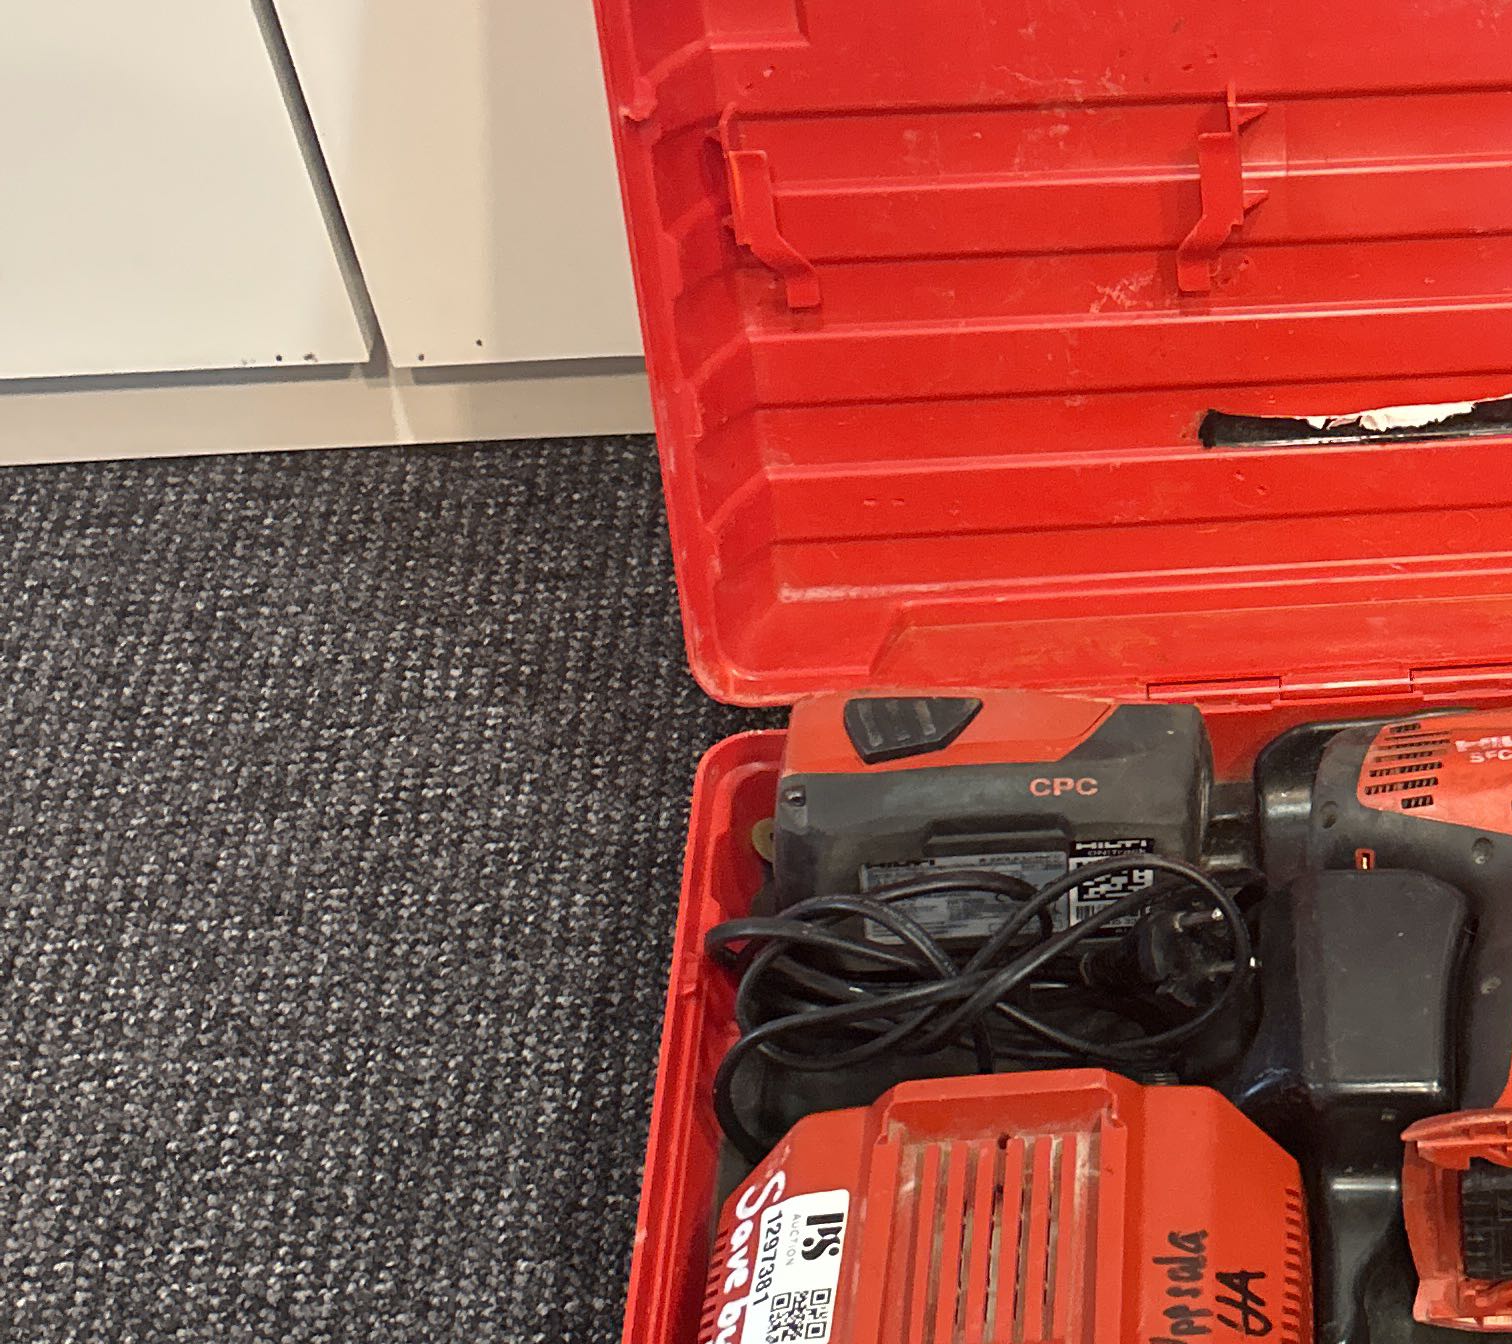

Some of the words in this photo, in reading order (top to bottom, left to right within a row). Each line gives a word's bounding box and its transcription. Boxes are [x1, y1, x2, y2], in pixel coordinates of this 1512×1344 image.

[1029, 777, 1099, 797] CPC
[1075, 839, 1148, 851] HILTI
[723, 1170, 787, 1295] Save
[752, 1210, 784, 1306] 1297381
[785, 1213, 802, 1267] AUCTION
